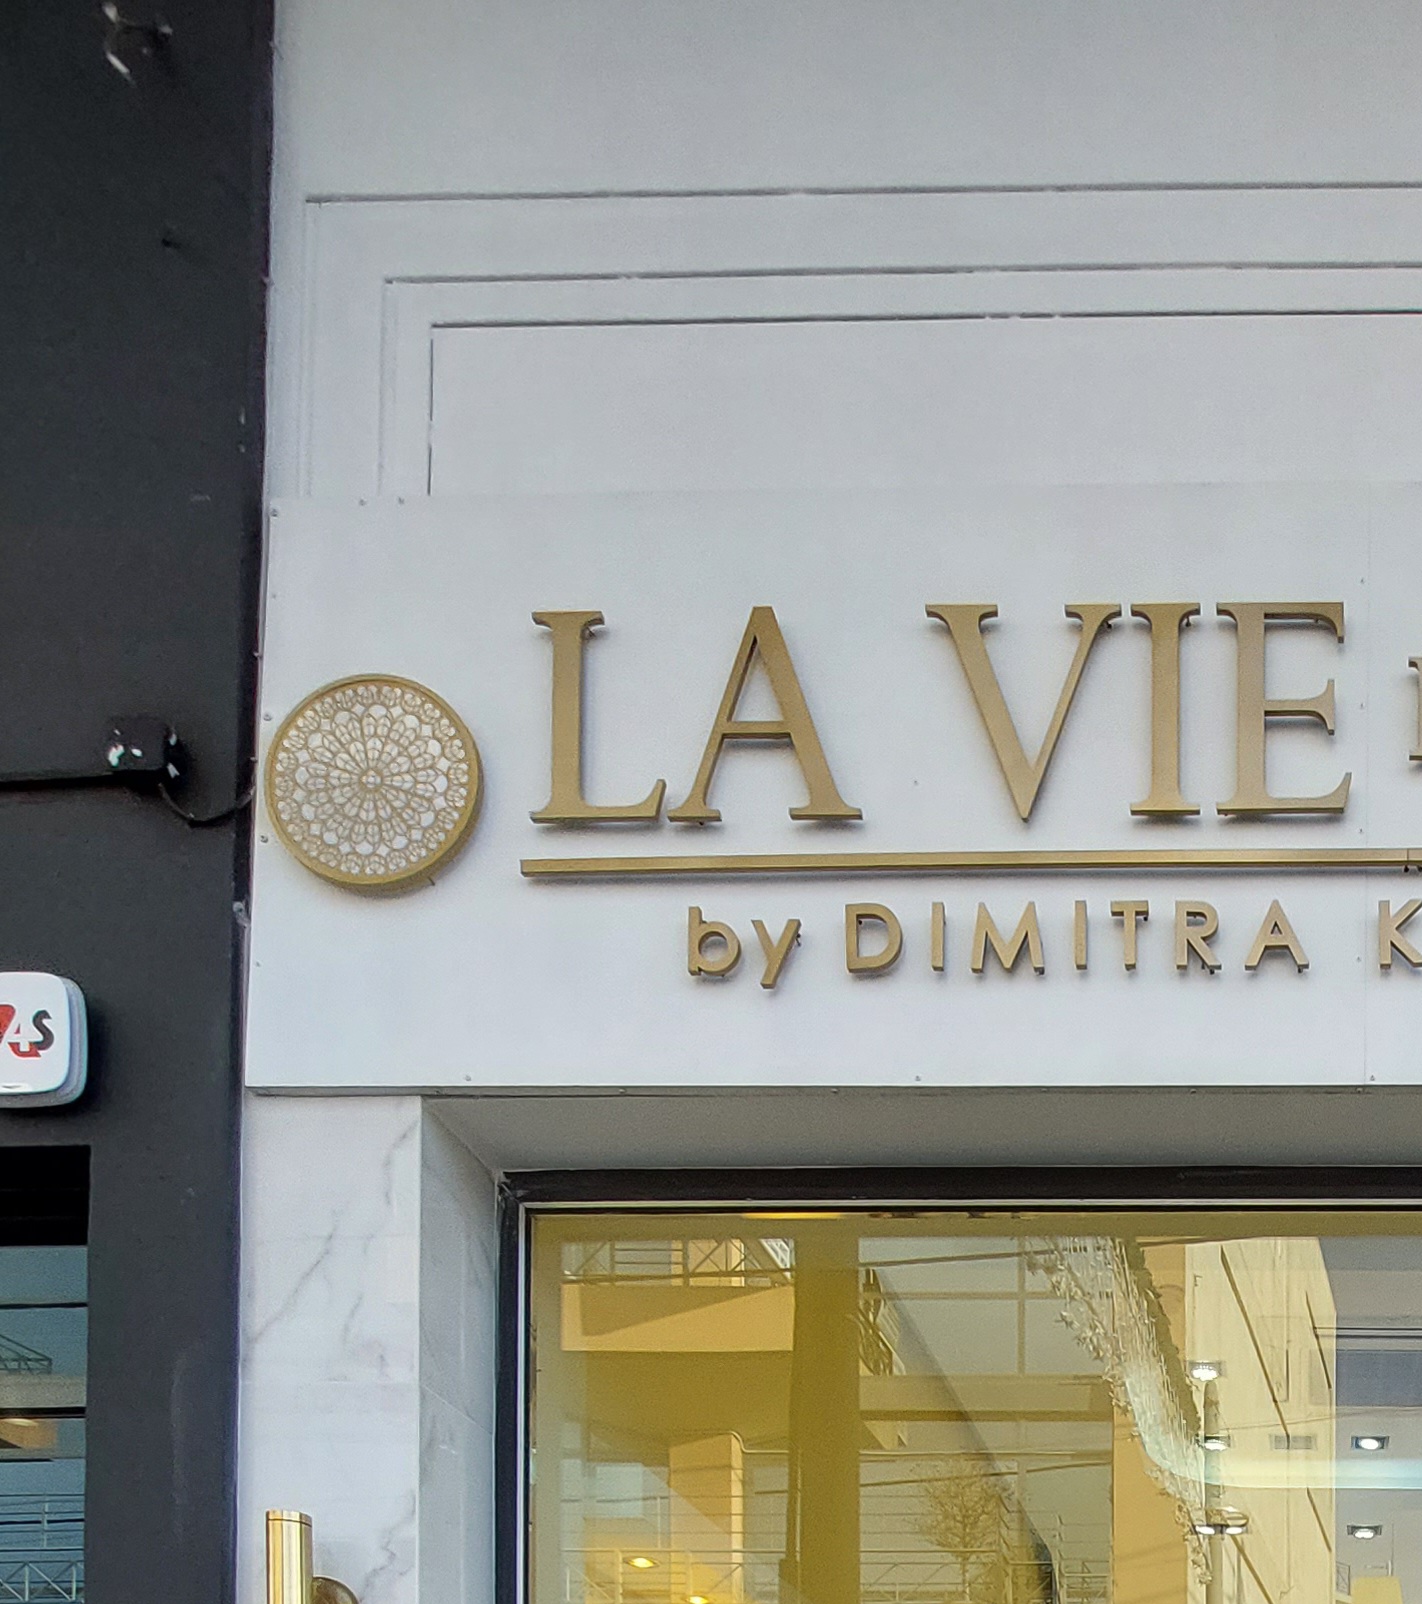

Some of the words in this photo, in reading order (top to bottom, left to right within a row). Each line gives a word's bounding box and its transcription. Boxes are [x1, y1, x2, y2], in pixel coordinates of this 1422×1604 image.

[530, 605, 864, 823] LA
[926, 601, 1353, 823] VIE
[686, 905, 801, 990] by
[844, 898, 1311, 974] DIMITRA
